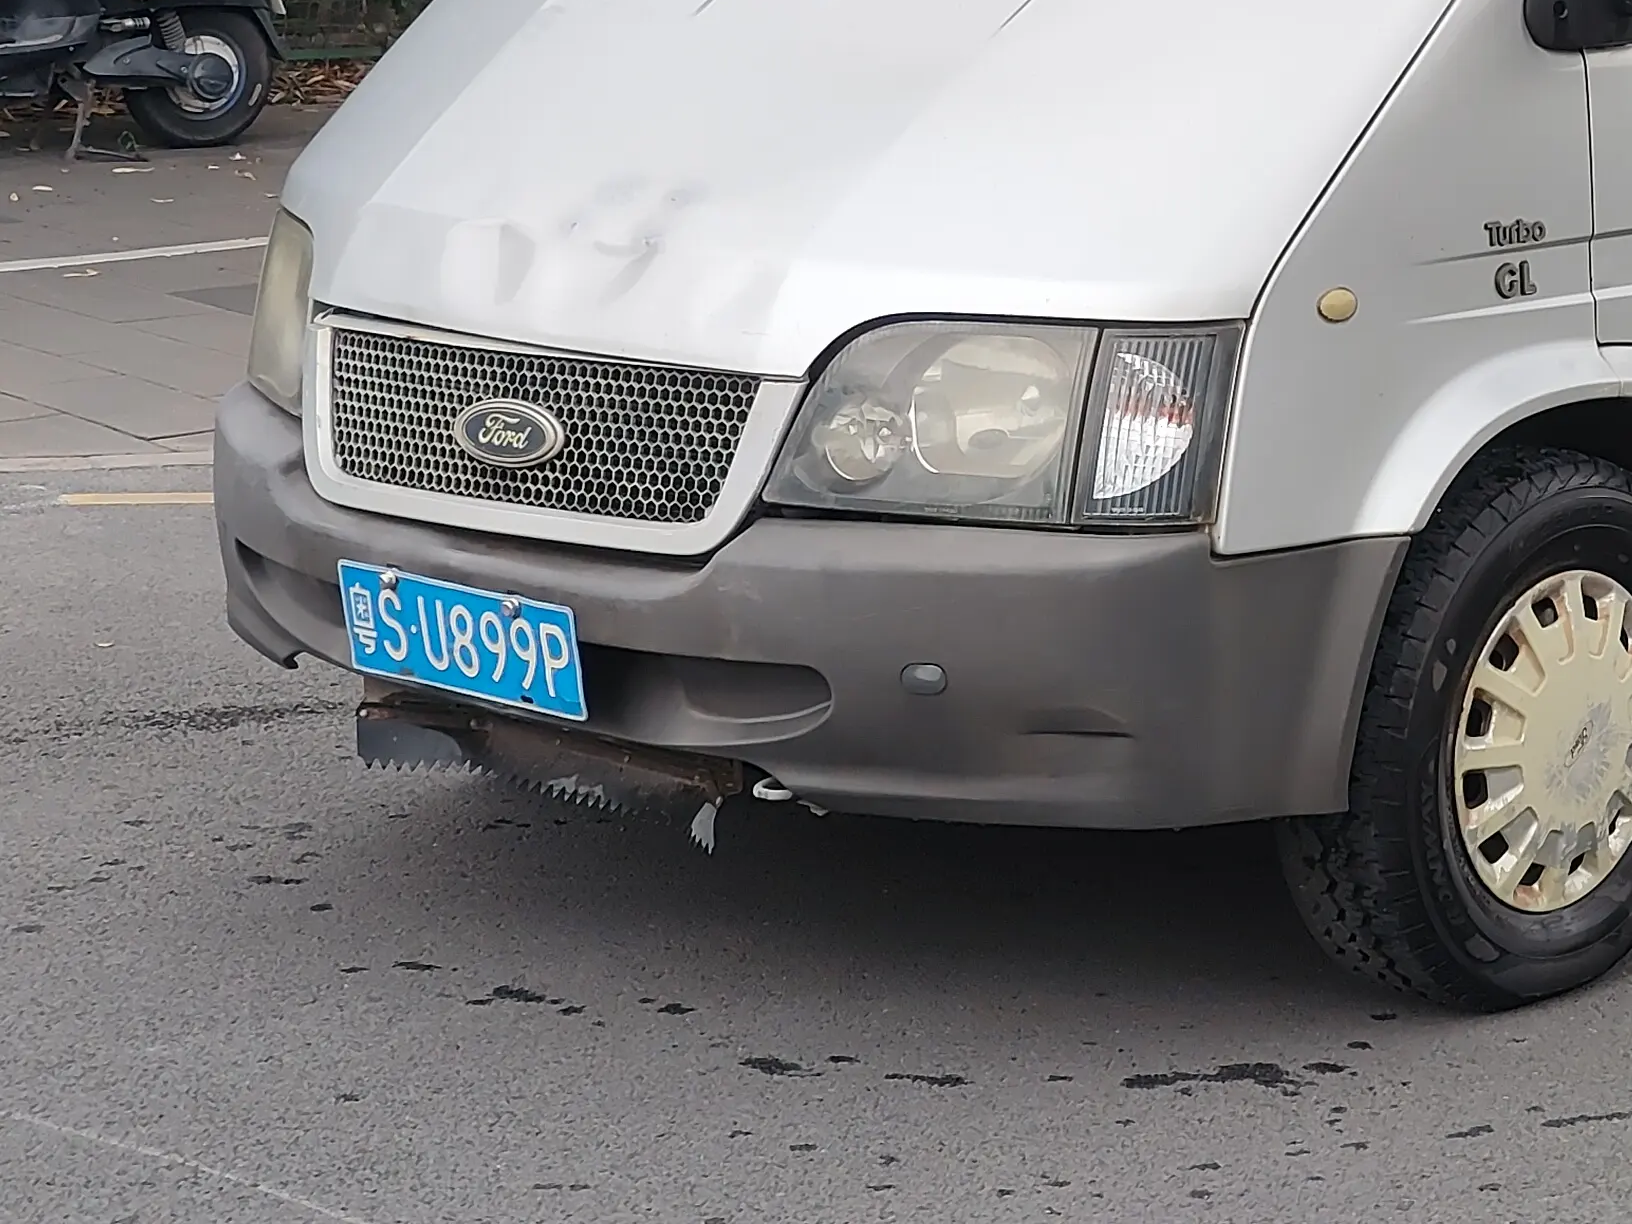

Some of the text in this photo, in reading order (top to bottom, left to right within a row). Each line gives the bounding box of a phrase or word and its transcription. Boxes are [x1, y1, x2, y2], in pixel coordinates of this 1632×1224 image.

[1483, 218, 1546, 247] Turbo
[1494, 260, 1537, 299] GL
[478, 413, 532, 449] Ford
